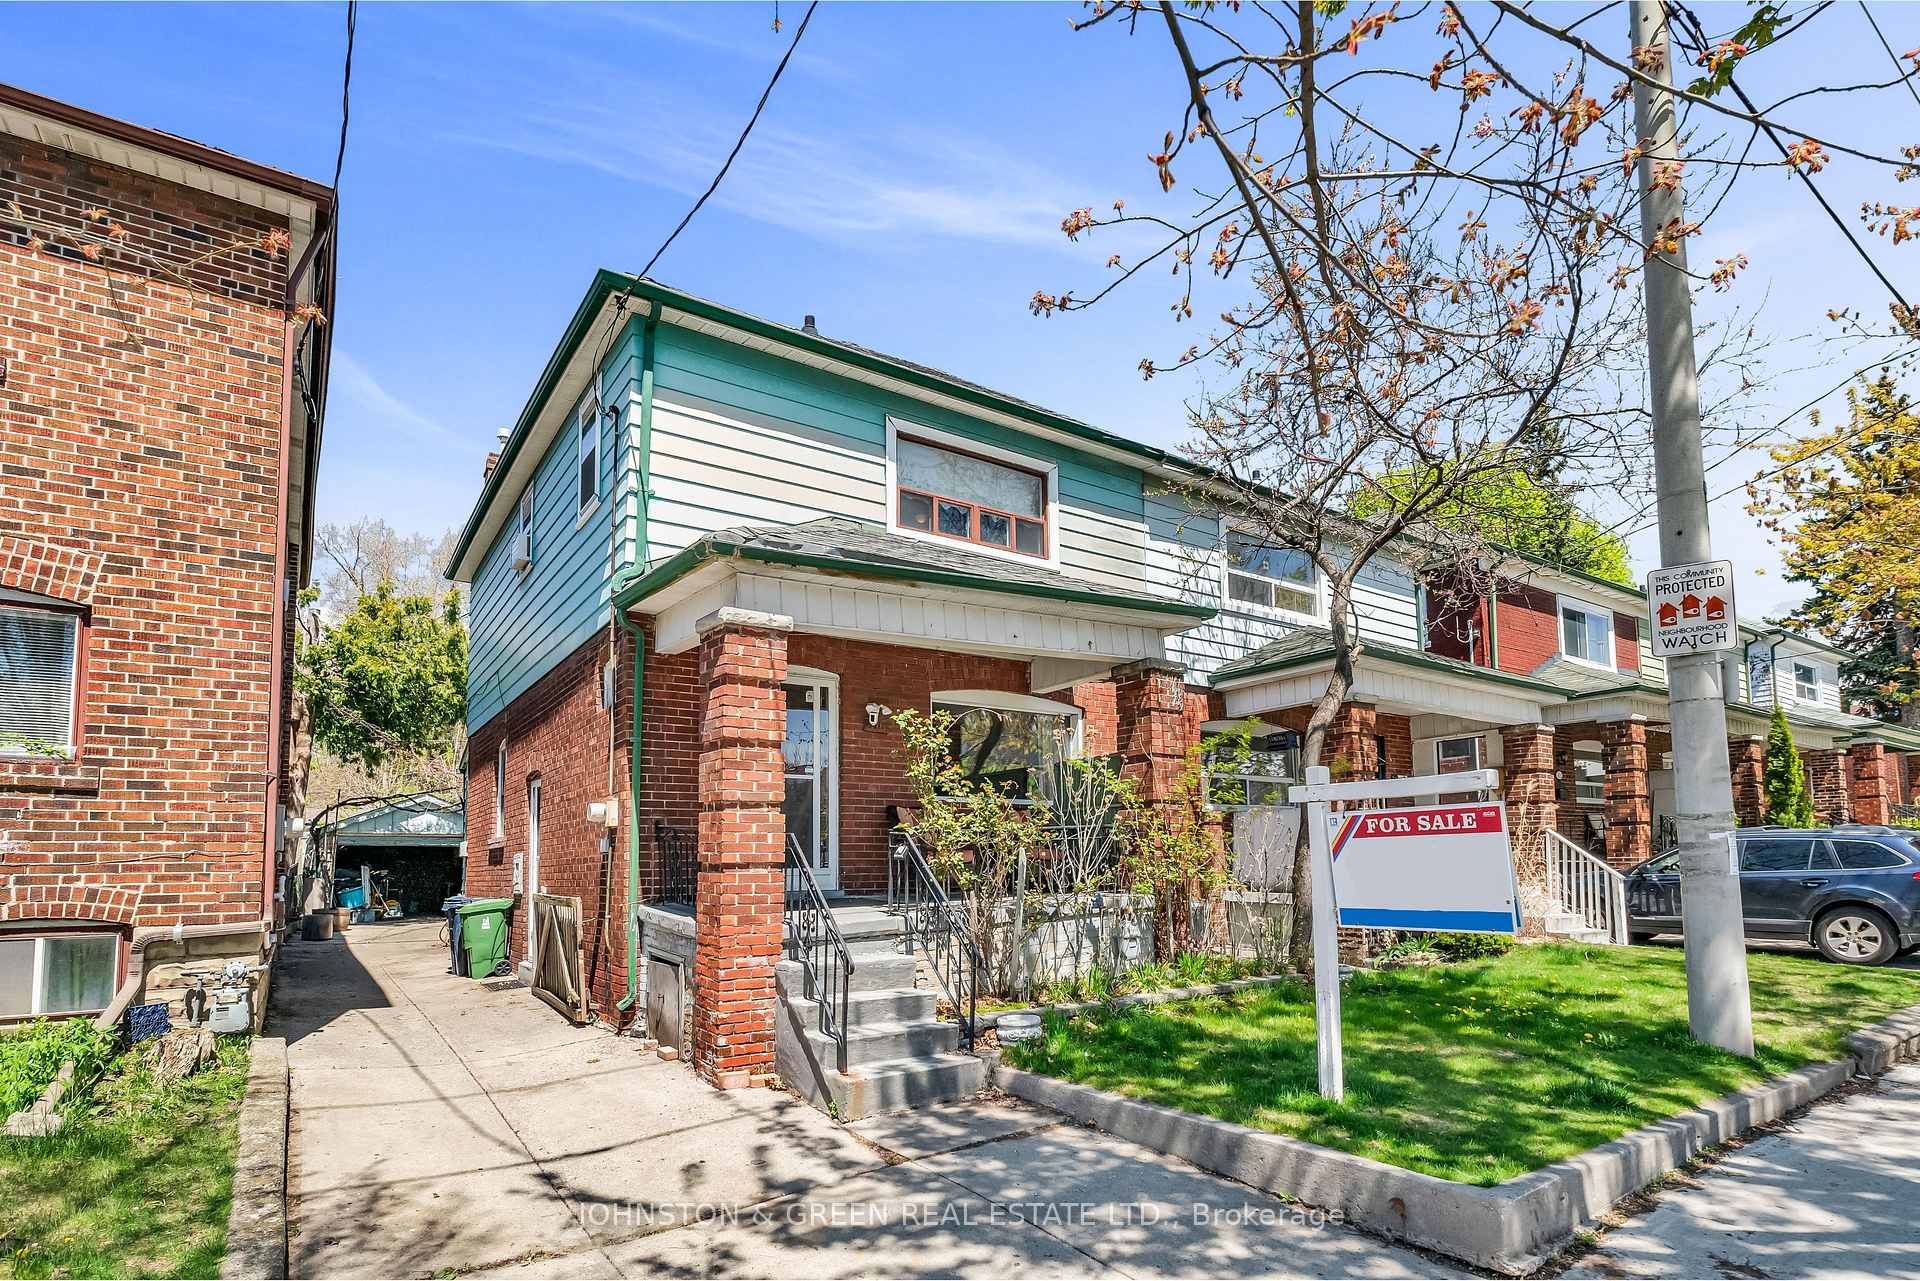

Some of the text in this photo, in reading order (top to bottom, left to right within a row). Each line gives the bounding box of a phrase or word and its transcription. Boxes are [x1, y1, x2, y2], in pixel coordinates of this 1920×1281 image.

[1673, 567, 1724, 581] COMMUNITY
[1655, 575, 1725, 596] PROTECTED
[1658, 622, 1728, 637] NEIGHBOURHOOD
[1661, 631, 1727, 649] WATCH
[1365, 812, 1477, 834] FOR SALE
